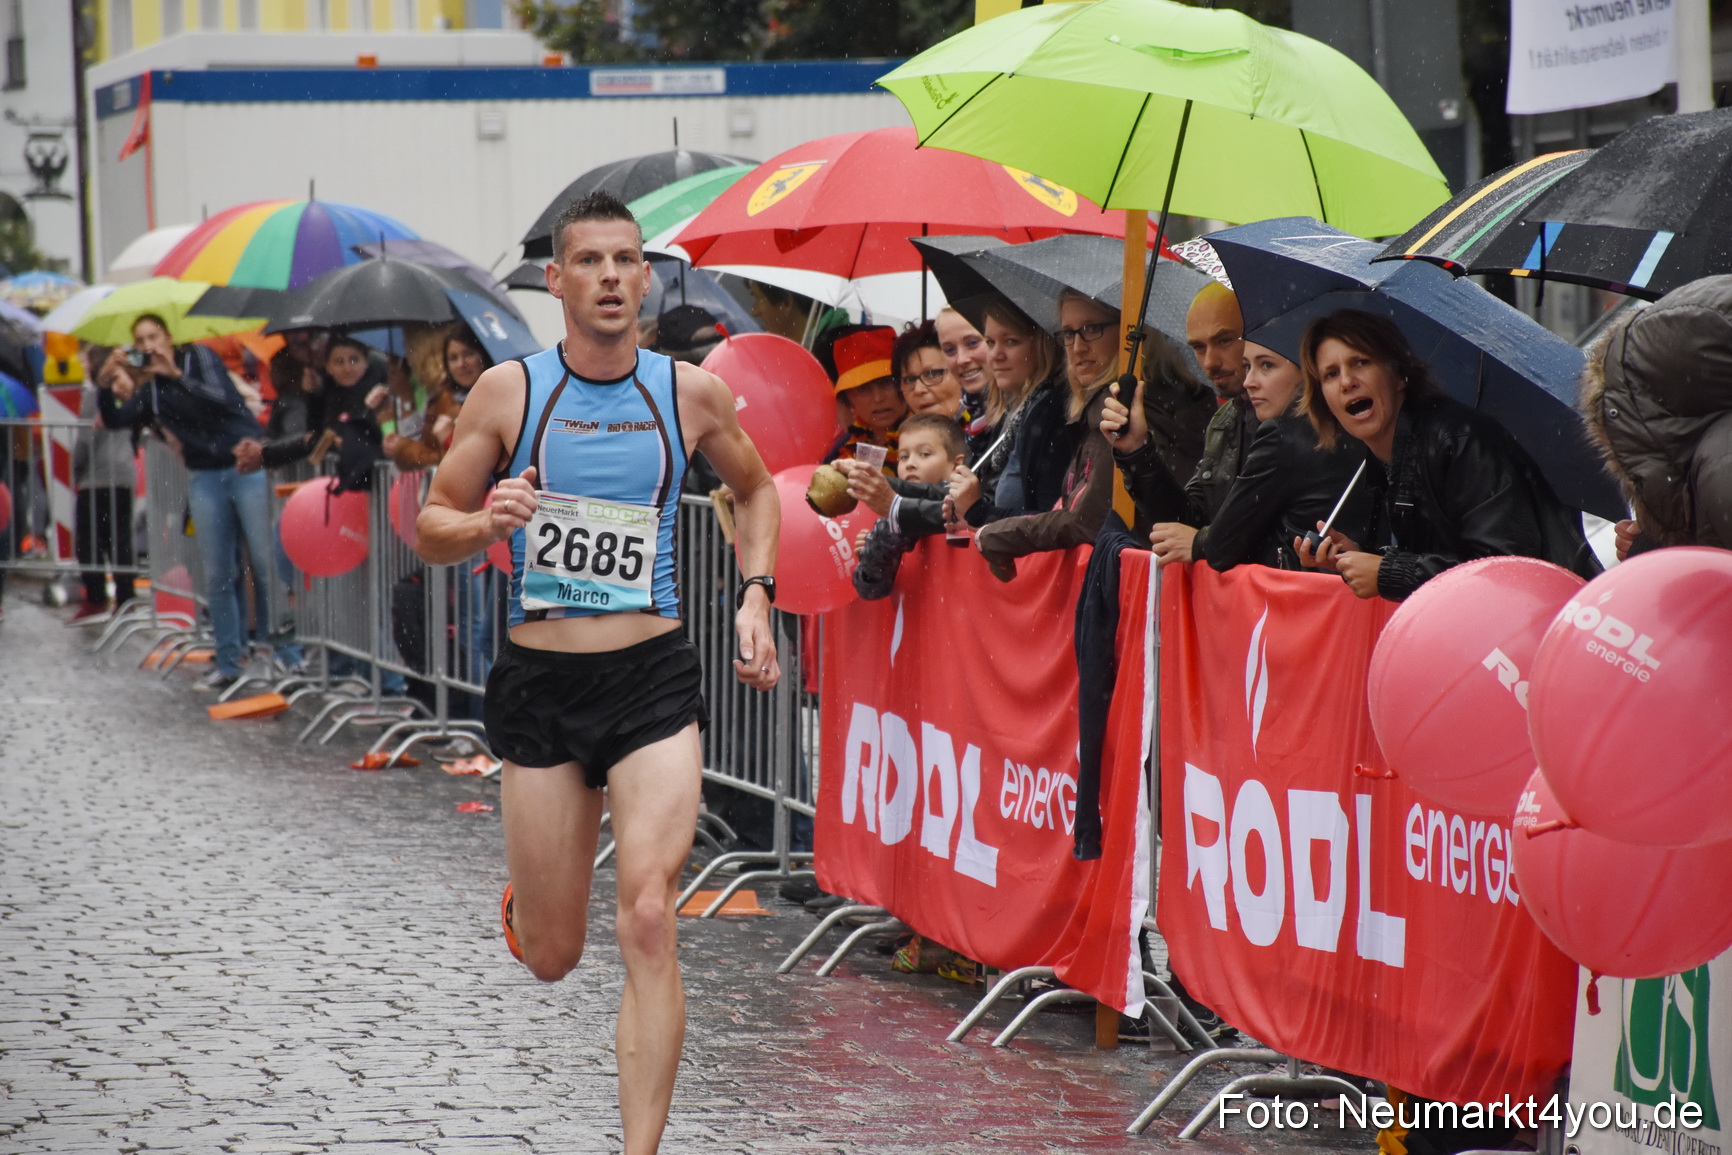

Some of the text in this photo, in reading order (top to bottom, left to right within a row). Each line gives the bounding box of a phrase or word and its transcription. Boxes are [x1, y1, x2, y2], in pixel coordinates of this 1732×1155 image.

[634, 420, 657, 431] RACER
[587, 502, 650, 526] BOCK
[536, 522, 645, 581] 2685
[528, 561, 534, 570] A
[557, 582, 610, 606] Marco
